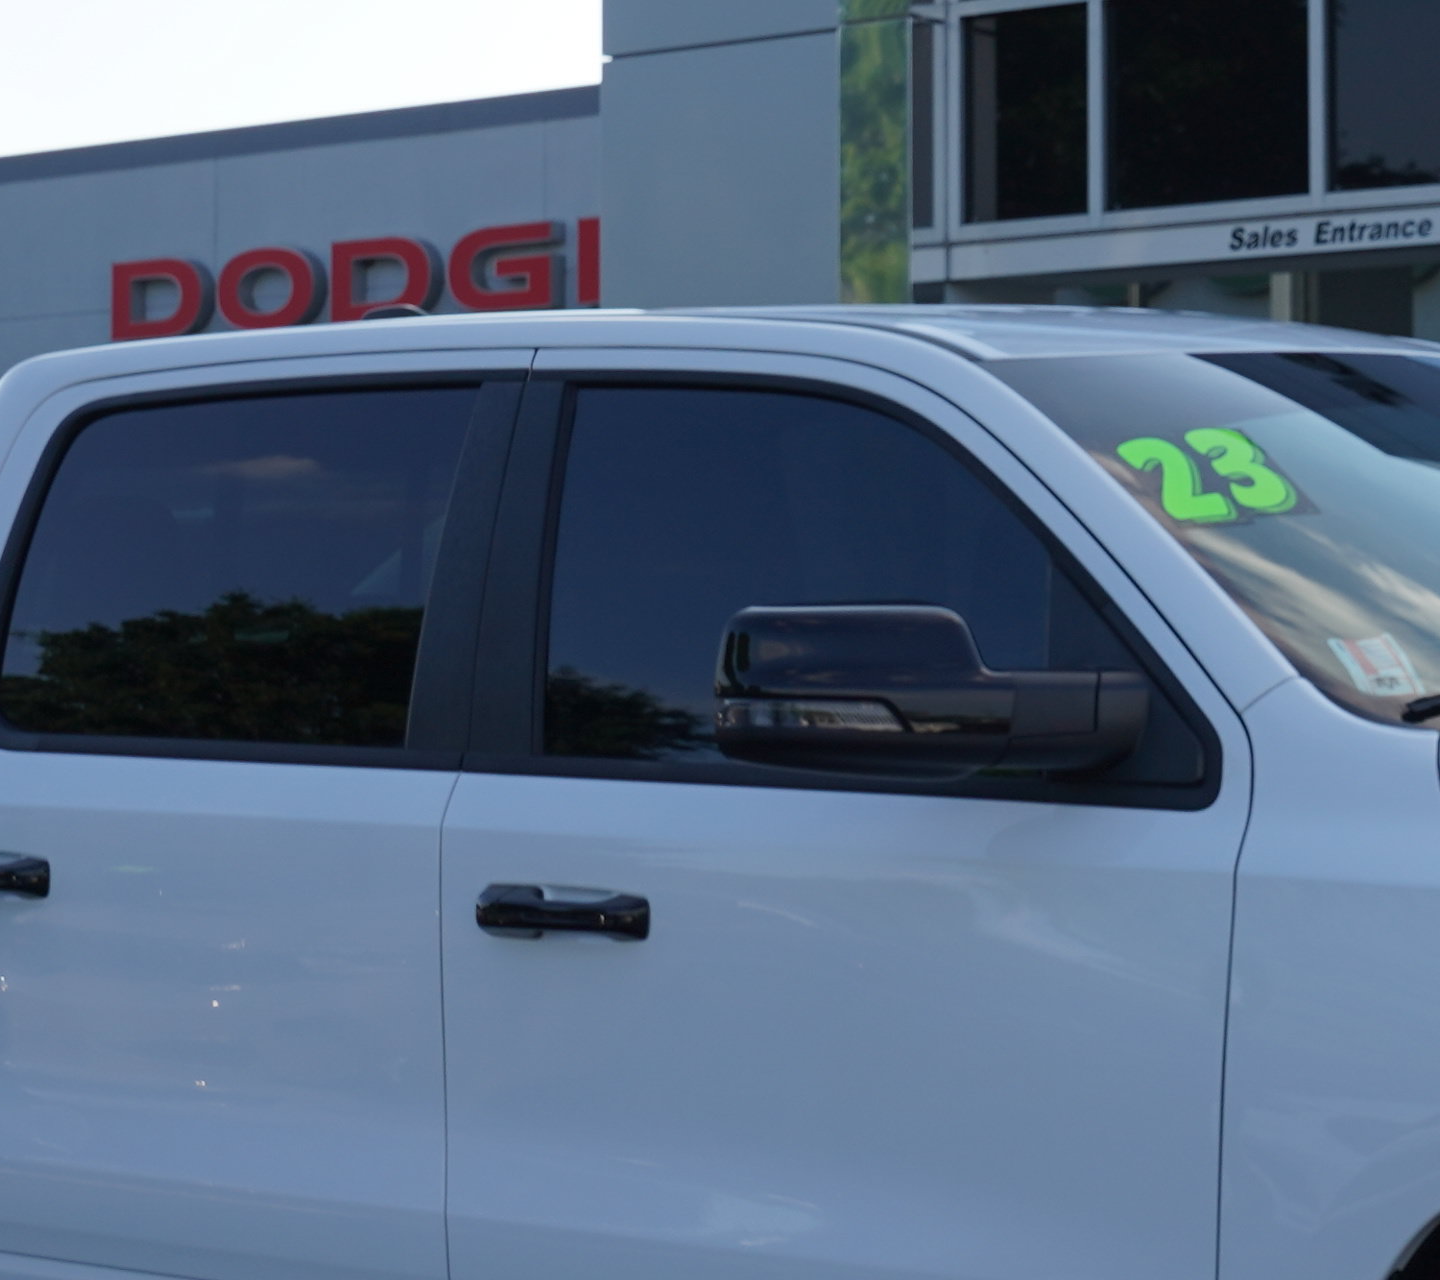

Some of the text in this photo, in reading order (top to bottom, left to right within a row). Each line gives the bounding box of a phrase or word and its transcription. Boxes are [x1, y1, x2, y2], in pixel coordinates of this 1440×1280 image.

[1229, 216, 1434, 253] Sales Entrance
[1116, 426, 1297, 524] 23
